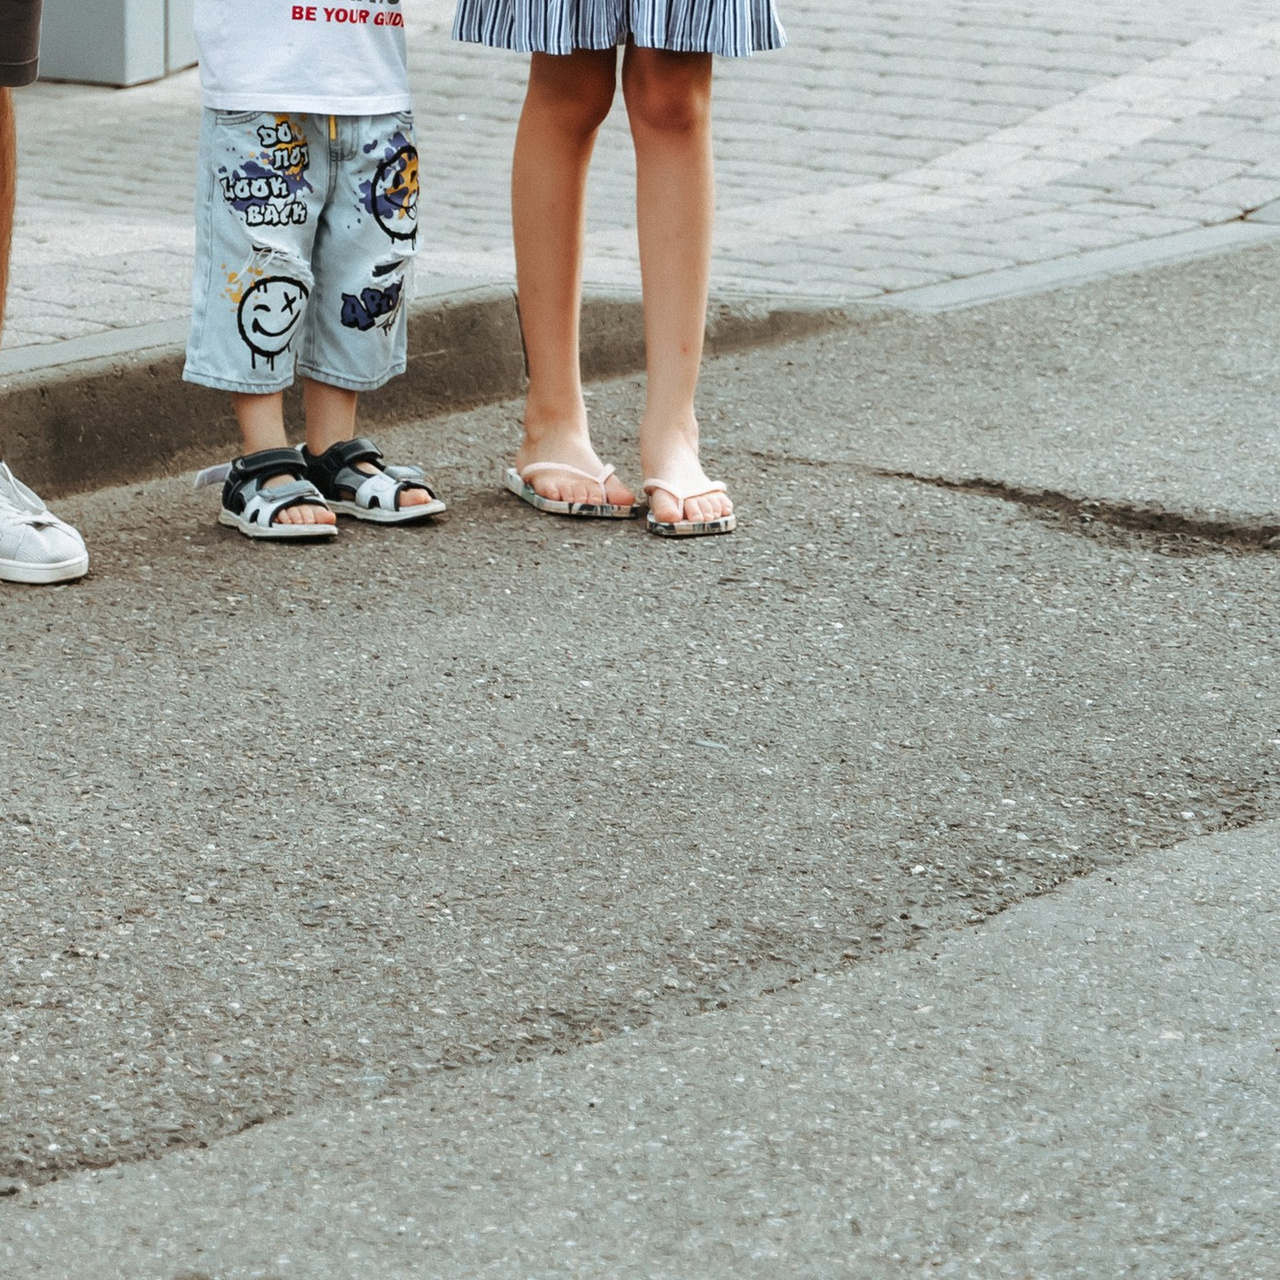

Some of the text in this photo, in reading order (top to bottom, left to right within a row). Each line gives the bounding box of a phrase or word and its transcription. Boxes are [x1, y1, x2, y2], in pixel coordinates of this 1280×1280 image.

[291, 5, 404, 28] BE YOUR GUID
[257, 120, 294, 148] DO
[220, 175, 289, 202] LOOK
[246, 201, 307, 226] BACK
